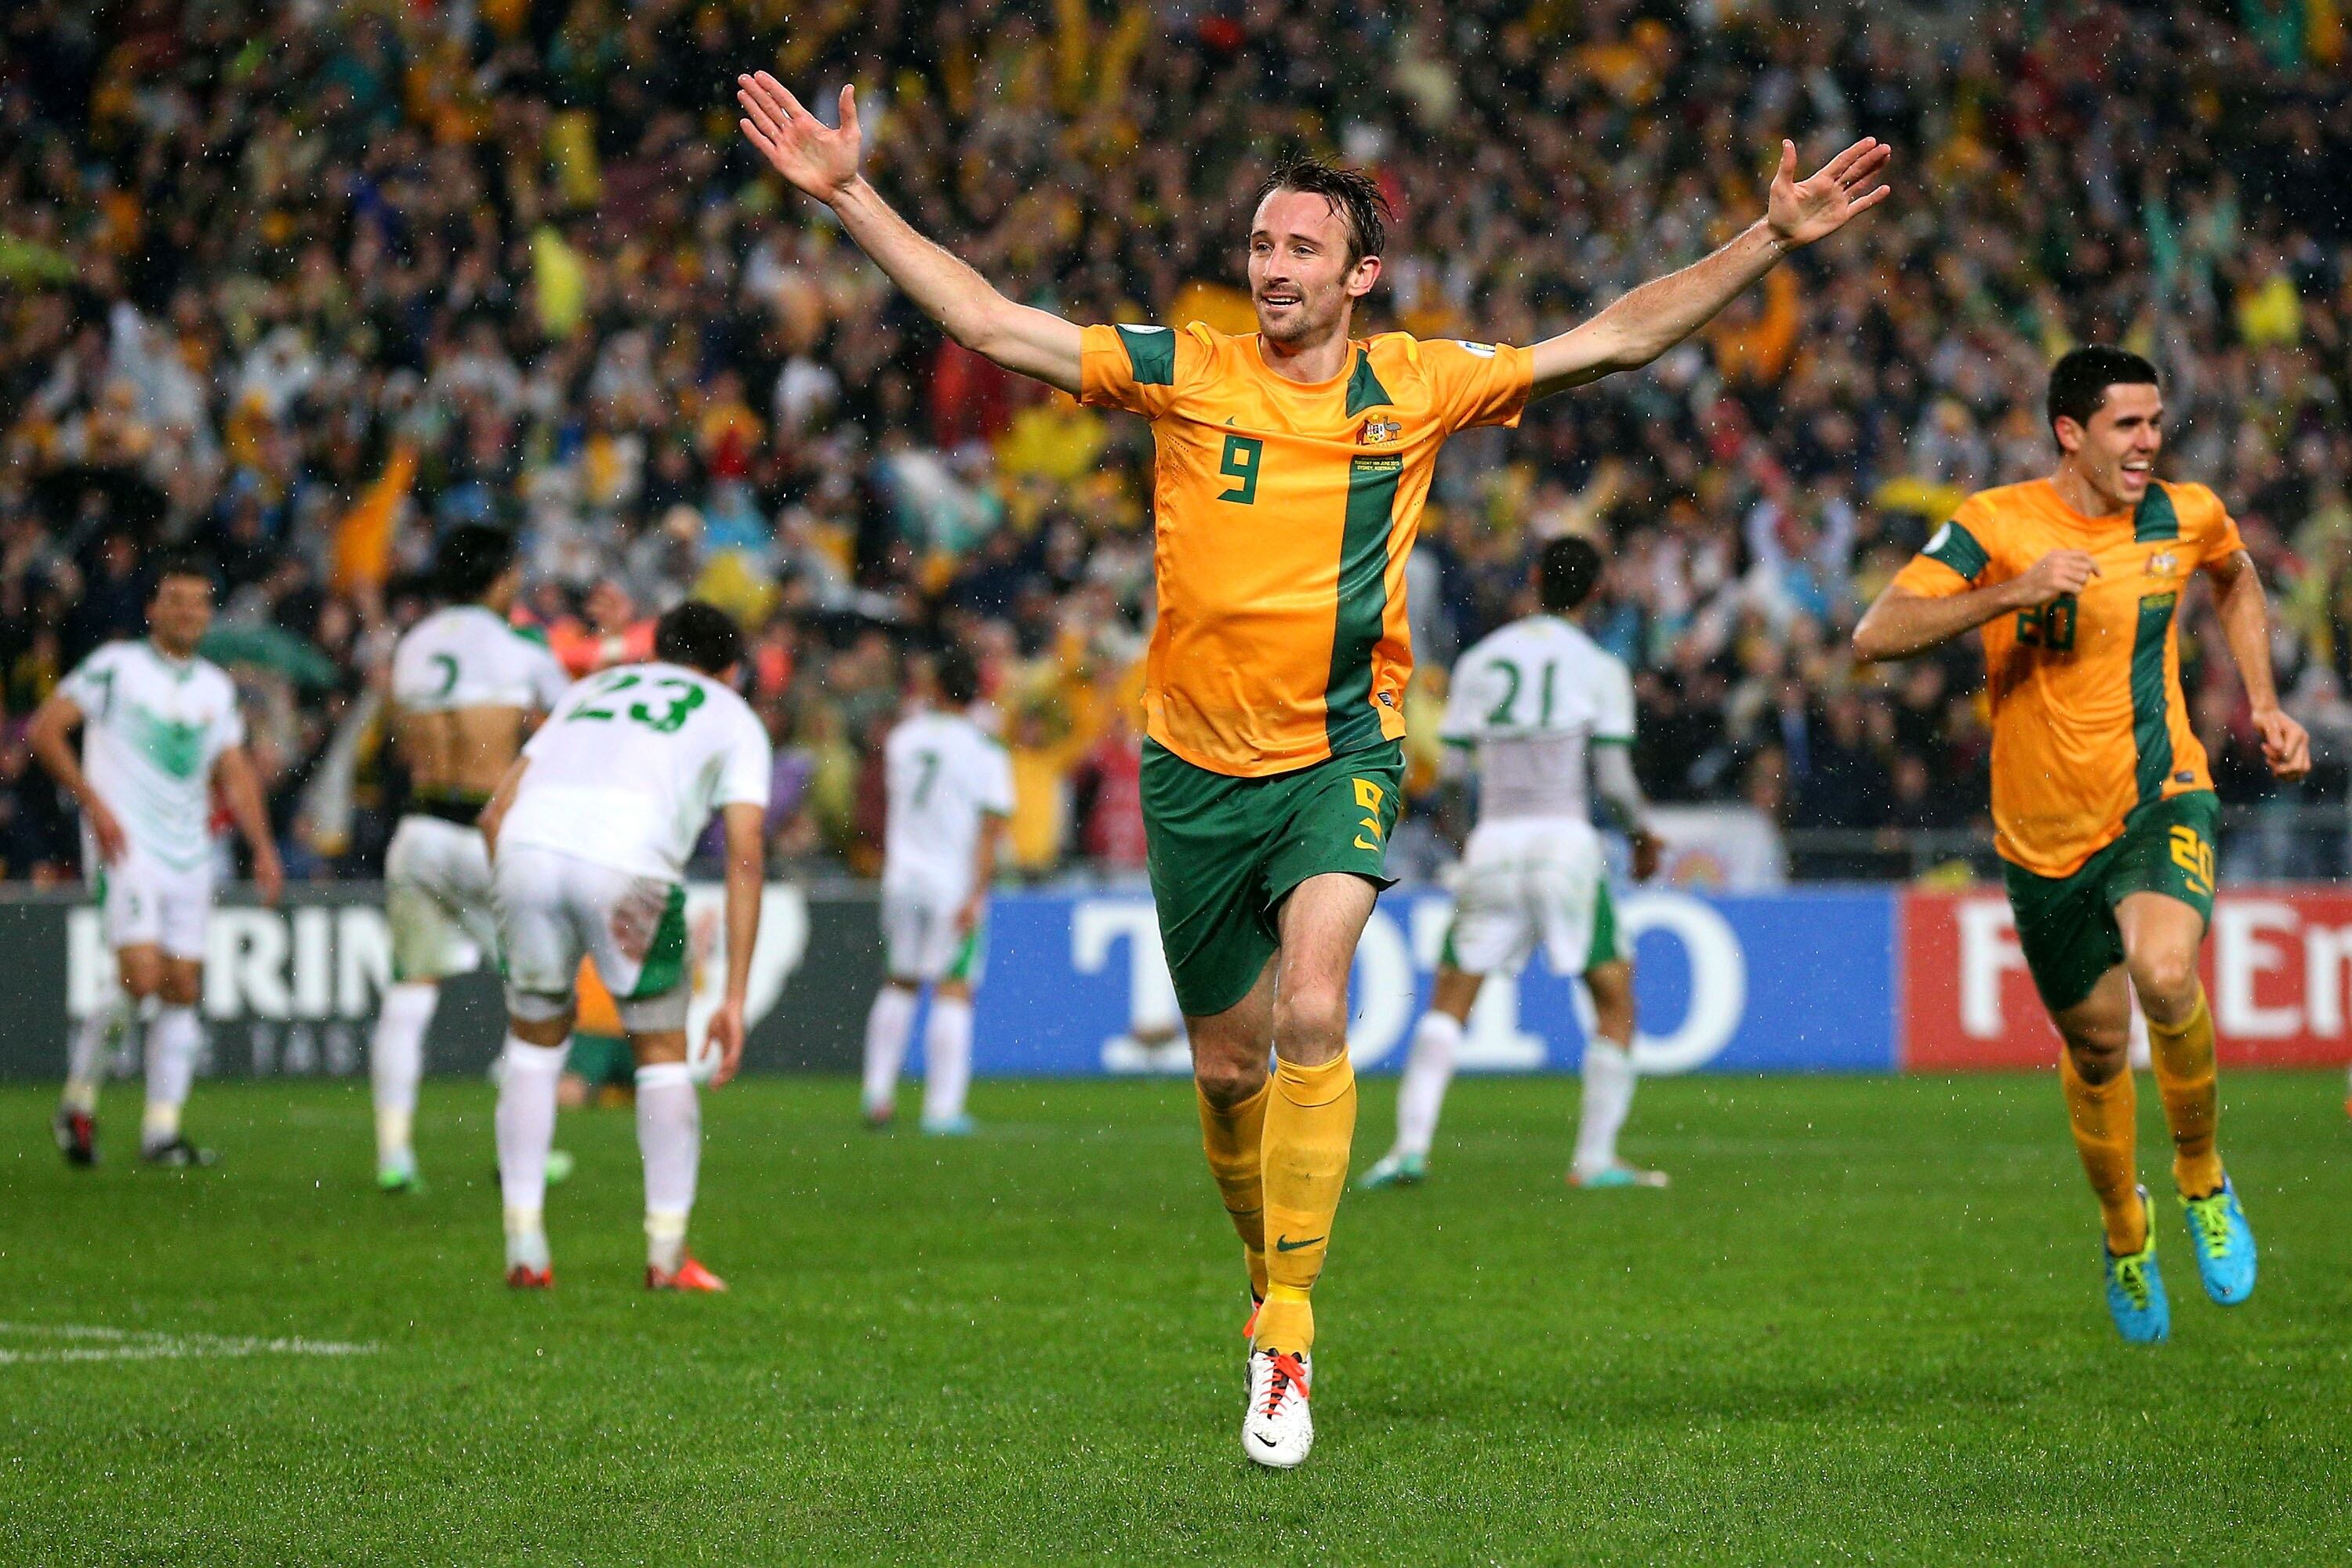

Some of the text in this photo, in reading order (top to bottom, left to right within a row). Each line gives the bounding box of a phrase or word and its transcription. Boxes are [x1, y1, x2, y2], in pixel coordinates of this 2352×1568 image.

[1217, 434, 1263, 505] 9
[2016, 590, 2077, 652] 20
[566, 673, 706, 735] 23
[1487, 657, 1556, 728] 21
[2169, 824, 2216, 892] 20
